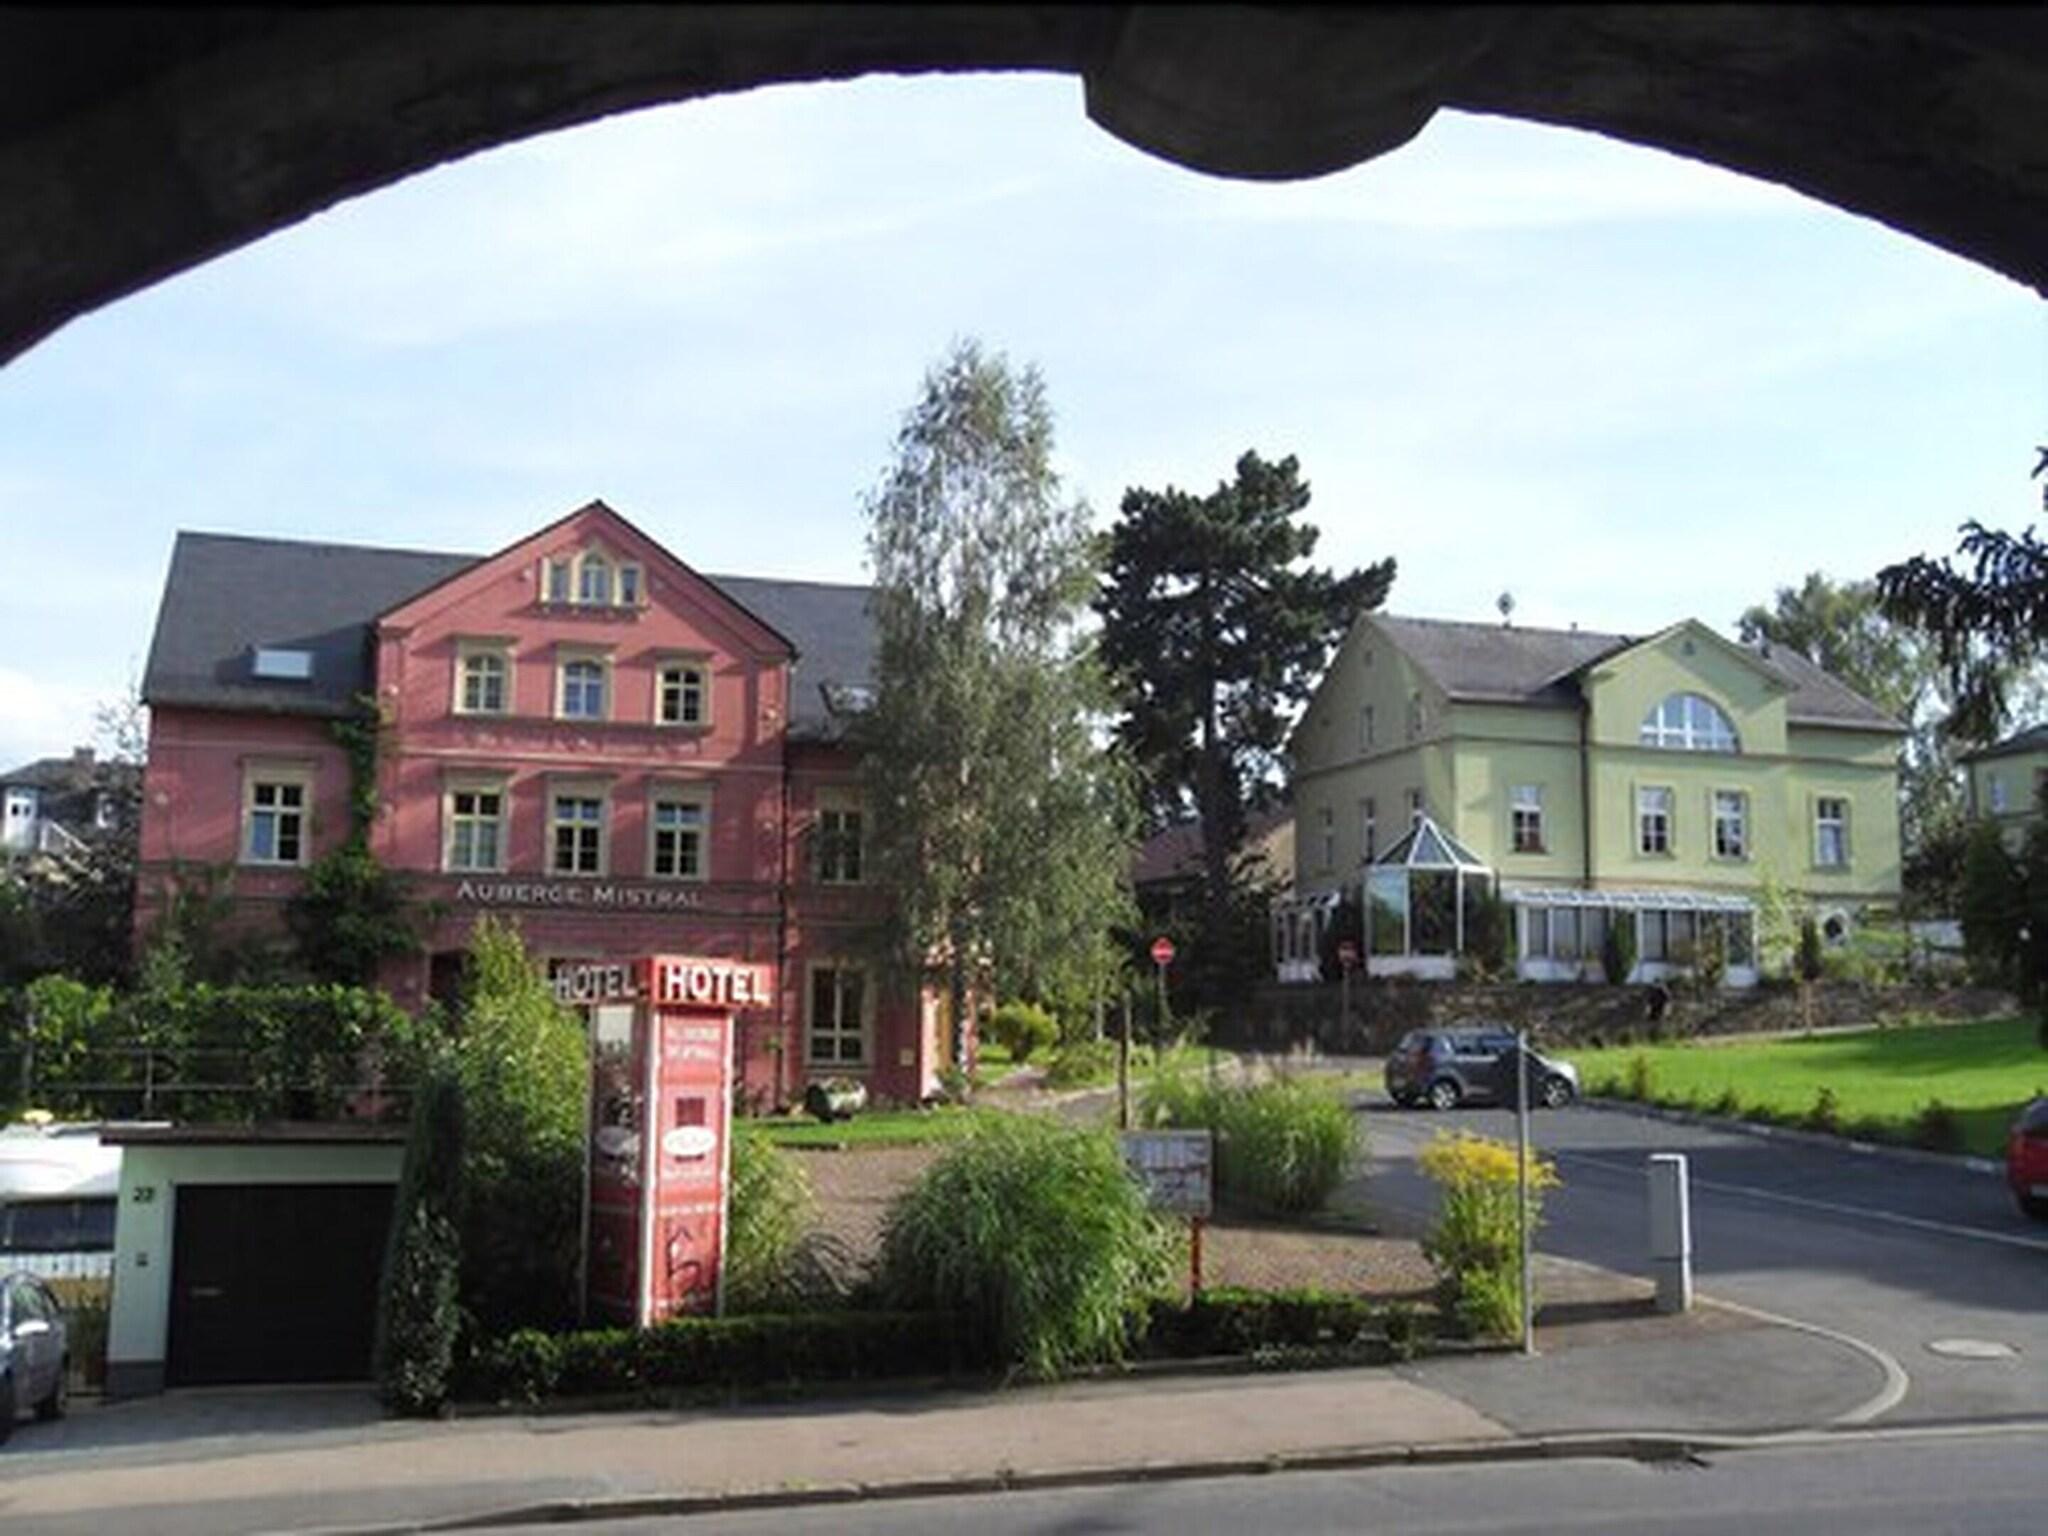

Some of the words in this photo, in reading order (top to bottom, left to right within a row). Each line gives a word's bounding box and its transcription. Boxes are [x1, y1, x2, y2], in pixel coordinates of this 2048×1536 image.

[457, 881, 584, 904] AUBERGE
[593, 886, 704, 908] MISTRAL
[555, 965, 638, 1001] HOTEL
[664, 964, 770, 1003] HOTEL
